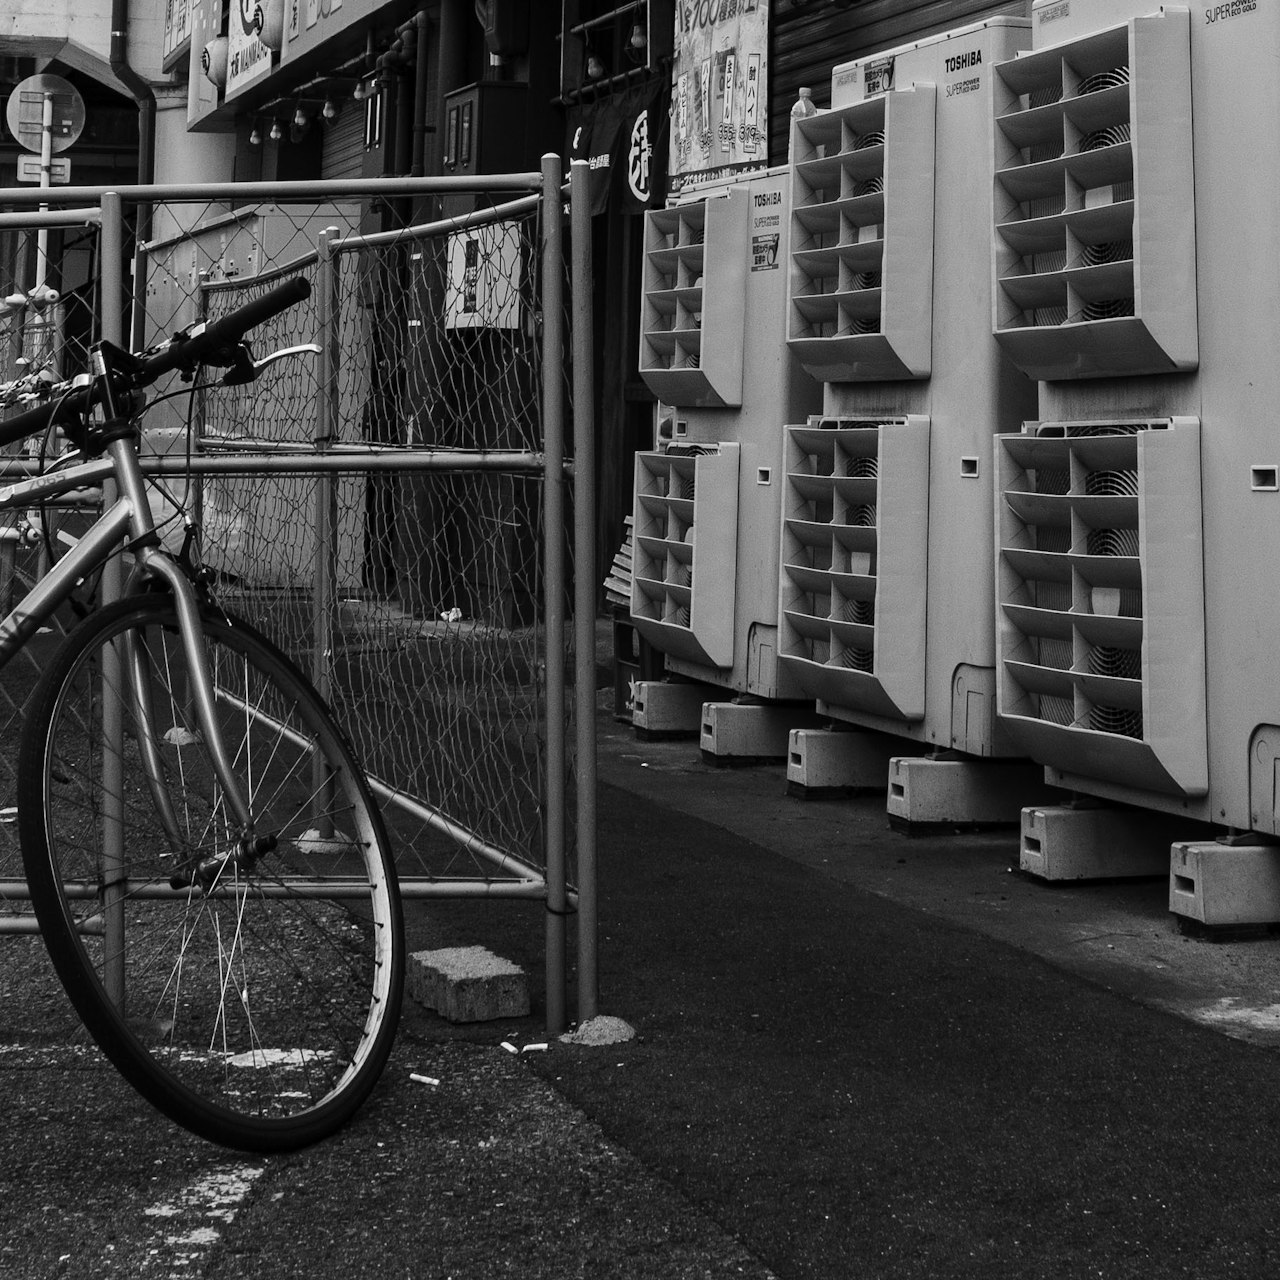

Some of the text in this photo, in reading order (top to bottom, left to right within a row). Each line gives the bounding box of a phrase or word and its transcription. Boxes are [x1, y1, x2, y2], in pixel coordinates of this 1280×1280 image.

[1205, 1, 1231, 25] SUPER
[1231, 2, 1257, 18] ECO GOLD
[944, 49, 982, 74] TOSHIBA
[754, 191, 782, 208] TOSHIBA
